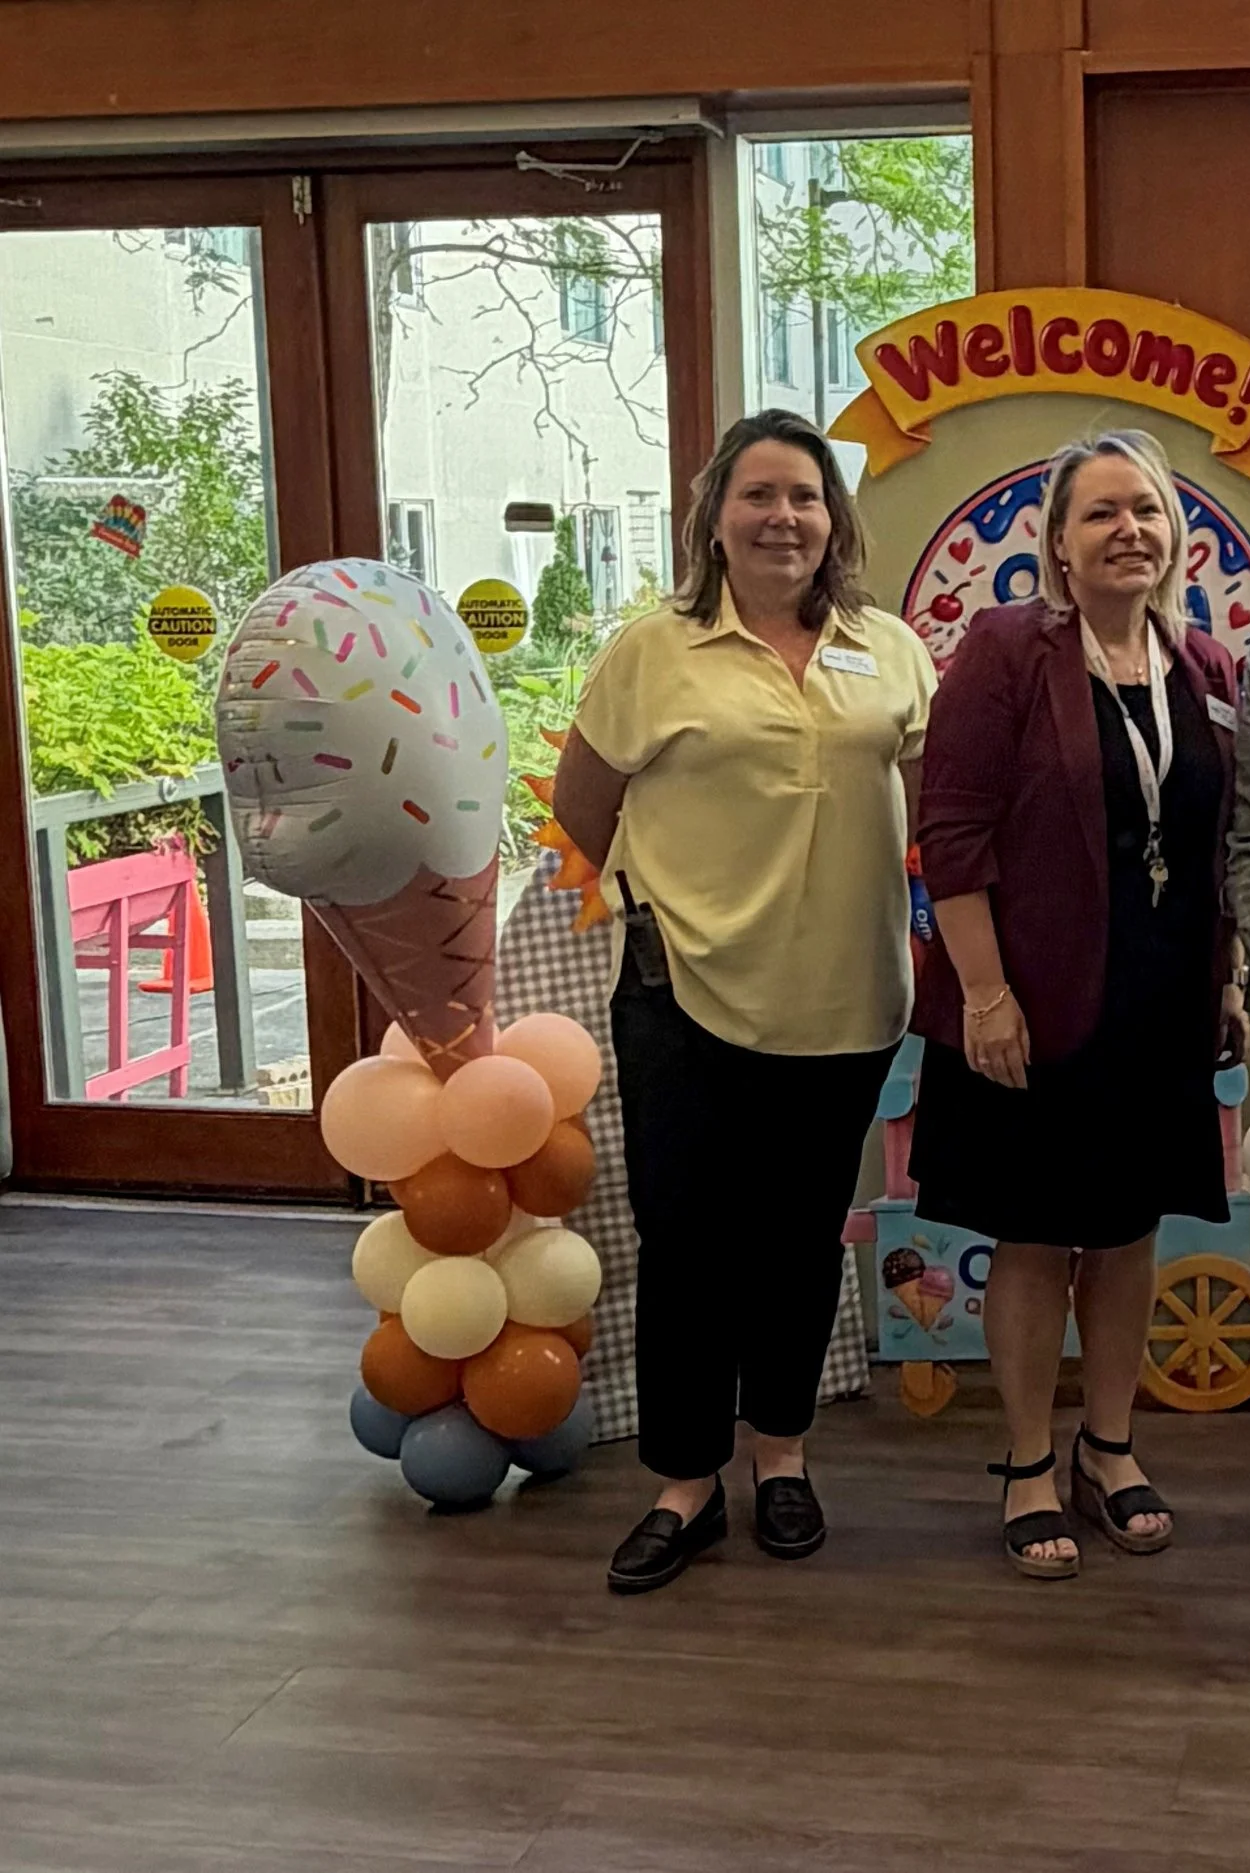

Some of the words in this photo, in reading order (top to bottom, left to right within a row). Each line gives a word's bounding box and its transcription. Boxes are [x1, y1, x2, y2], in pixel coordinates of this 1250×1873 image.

[460, 599, 523, 609] AUTOMATIC
[151, 606, 213, 616] AUTOMATIC
[151, 619, 214, 632] CAUTION
[167, 637, 199, 647] DOOR
